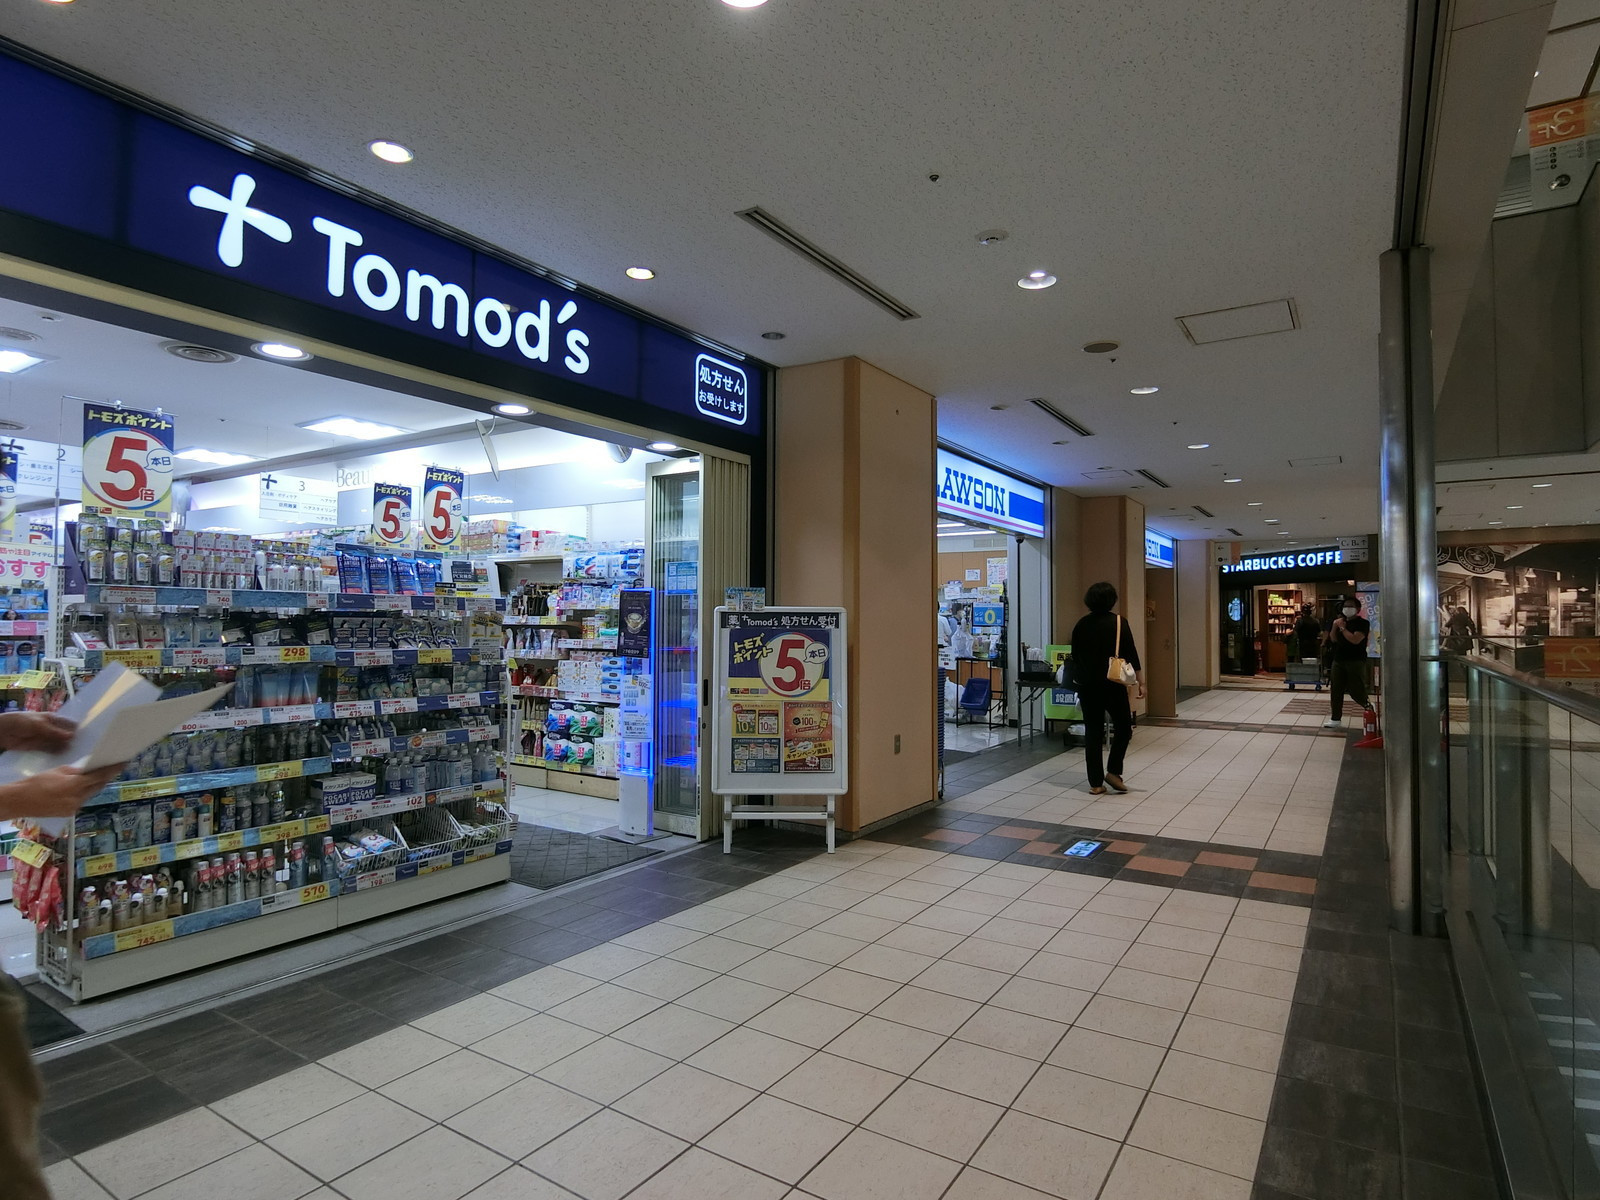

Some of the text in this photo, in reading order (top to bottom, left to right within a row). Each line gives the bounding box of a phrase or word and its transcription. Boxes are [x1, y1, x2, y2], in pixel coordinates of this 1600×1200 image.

[312, 216, 590, 374] Tomod's
[700, 364, 744, 396] 処方せん
[699, 389, 744, 414] お受けします
[87, 409, 172, 430] トモズポイント
[56, 448, 66, 461] 2
[151, 456, 171, 466] 本日
[299, 481, 305, 491] 3
[937, 466, 1005, 516] AWSON
[729, 615, 837, 626] 薬 Tomod's 処方せん受付
[734, 632, 765, 652] トモズ
[283, 648, 306, 656] 298
[734, 646, 774, 664] ポイント
[808, 648, 826, 658] 本日
[323, 793, 350, 801] POCARI
[350, 788, 376, 797] POCARI
[350, 793, 374, 801] SWEAT
[323, 798, 347, 806] SWEAT
[407, 796, 422, 806] 102
[276, 832, 291, 840] 398
[303, 885, 326, 897] 570
